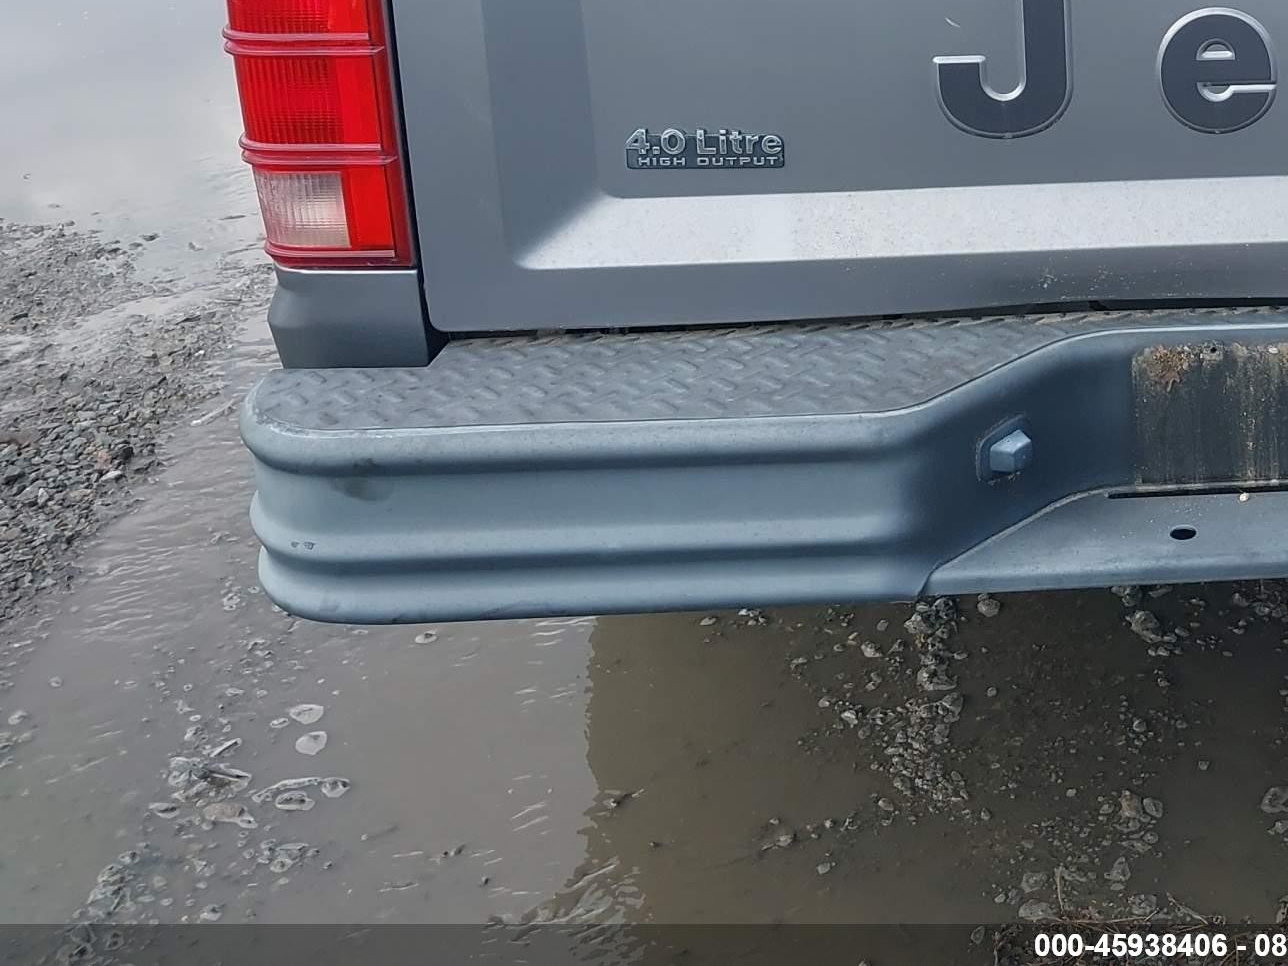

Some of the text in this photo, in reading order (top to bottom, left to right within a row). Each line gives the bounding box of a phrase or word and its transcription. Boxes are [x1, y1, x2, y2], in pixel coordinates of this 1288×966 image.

[624, 128, 783, 155] 4.0 Litre
[637, 155, 779, 167] HIGH OUTPUT
